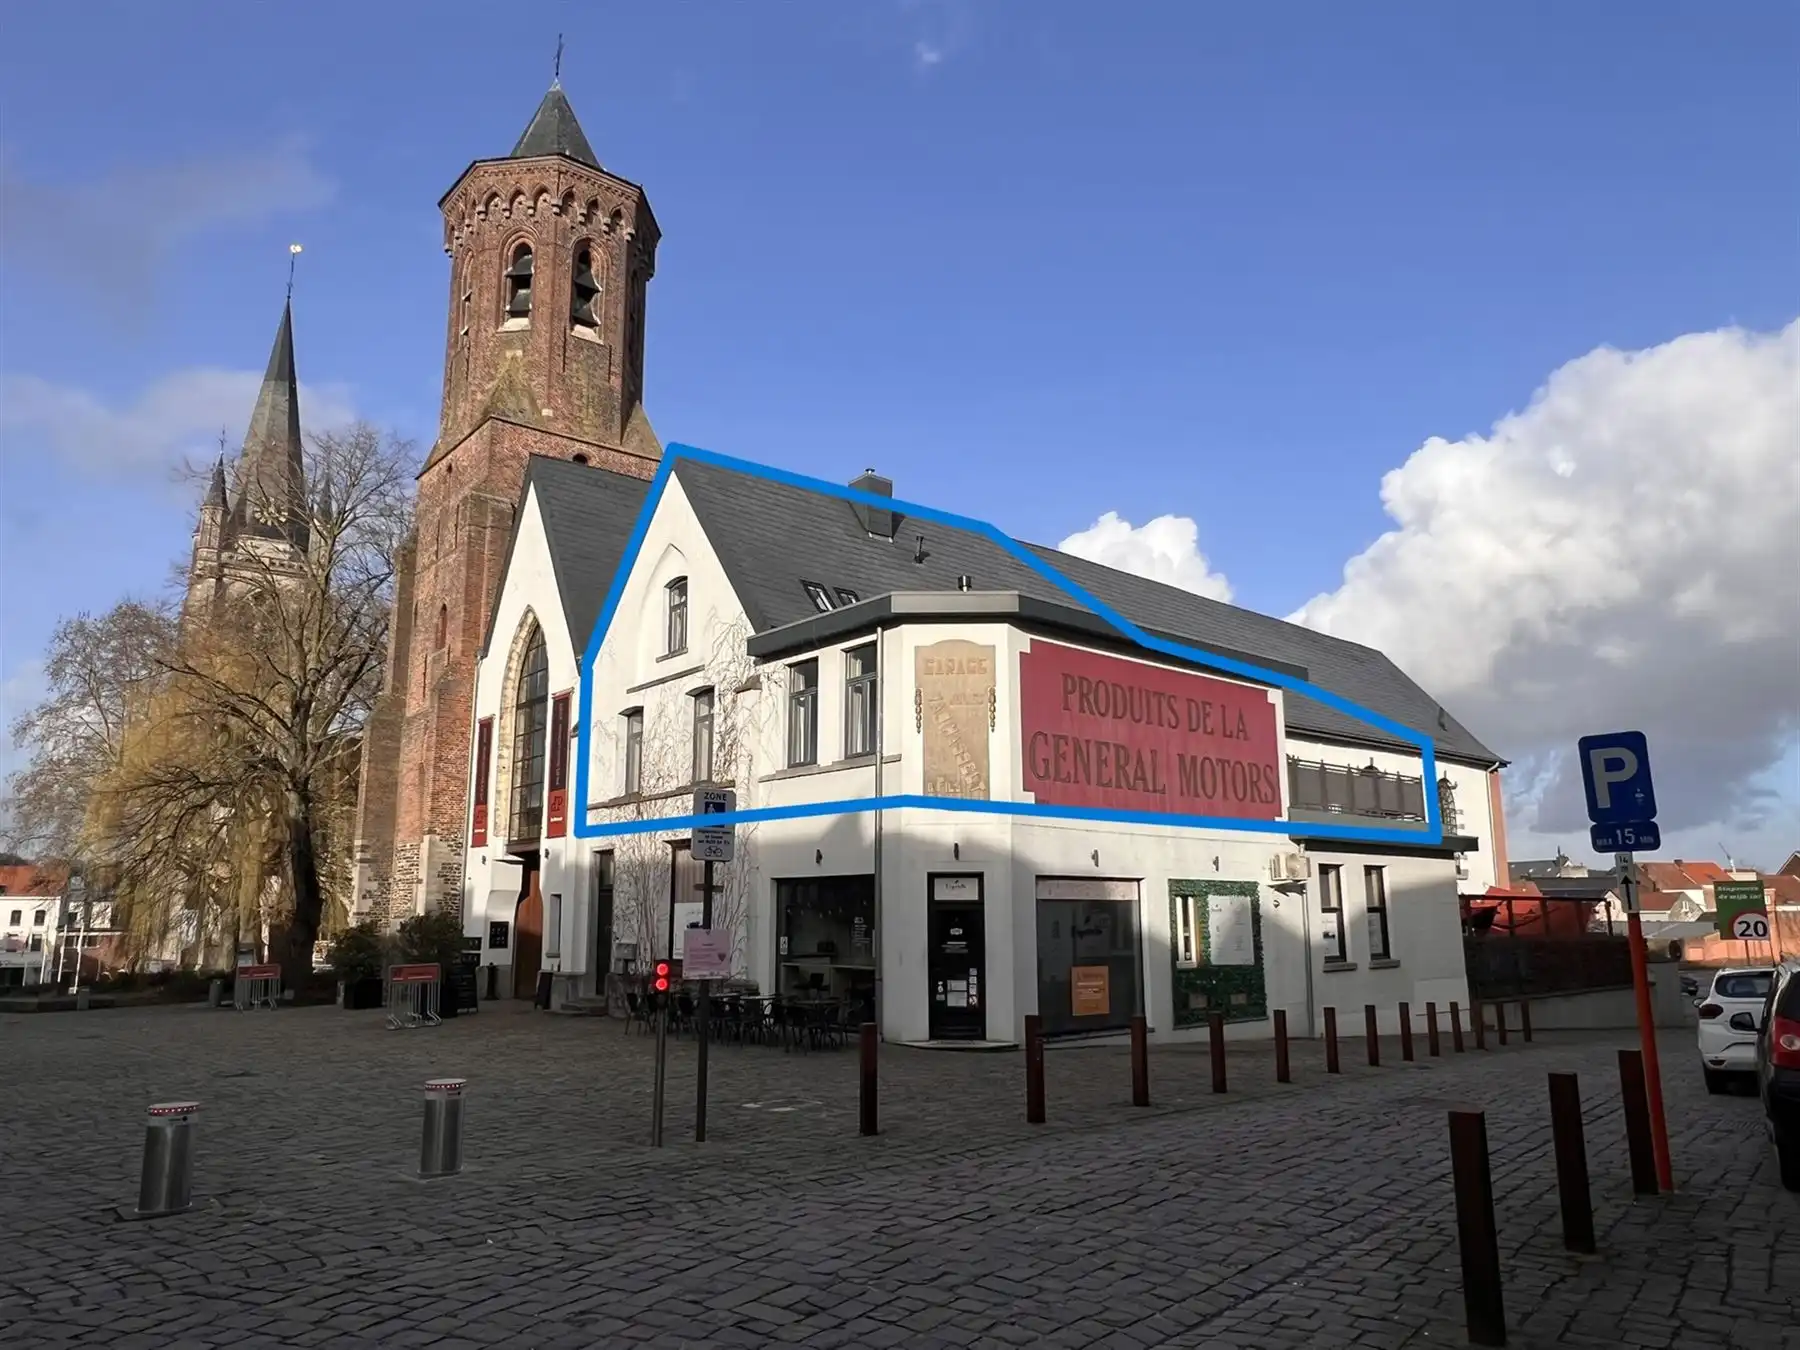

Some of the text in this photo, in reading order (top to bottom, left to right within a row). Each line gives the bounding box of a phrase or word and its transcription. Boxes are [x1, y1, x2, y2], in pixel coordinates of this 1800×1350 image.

[924, 658, 988, 676] GARAGE
[1061, 673, 1250, 741] PRODUITS DE LA
[1029, 730, 1166, 795] GENERAL
[1177, 753, 1277, 804] MOTORS
[1589, 747, 1639, 809] P
[704, 791, 727, 801] ZONE
[1615, 828, 1636, 845] 15
[1737, 920, 1768, 938] 20
